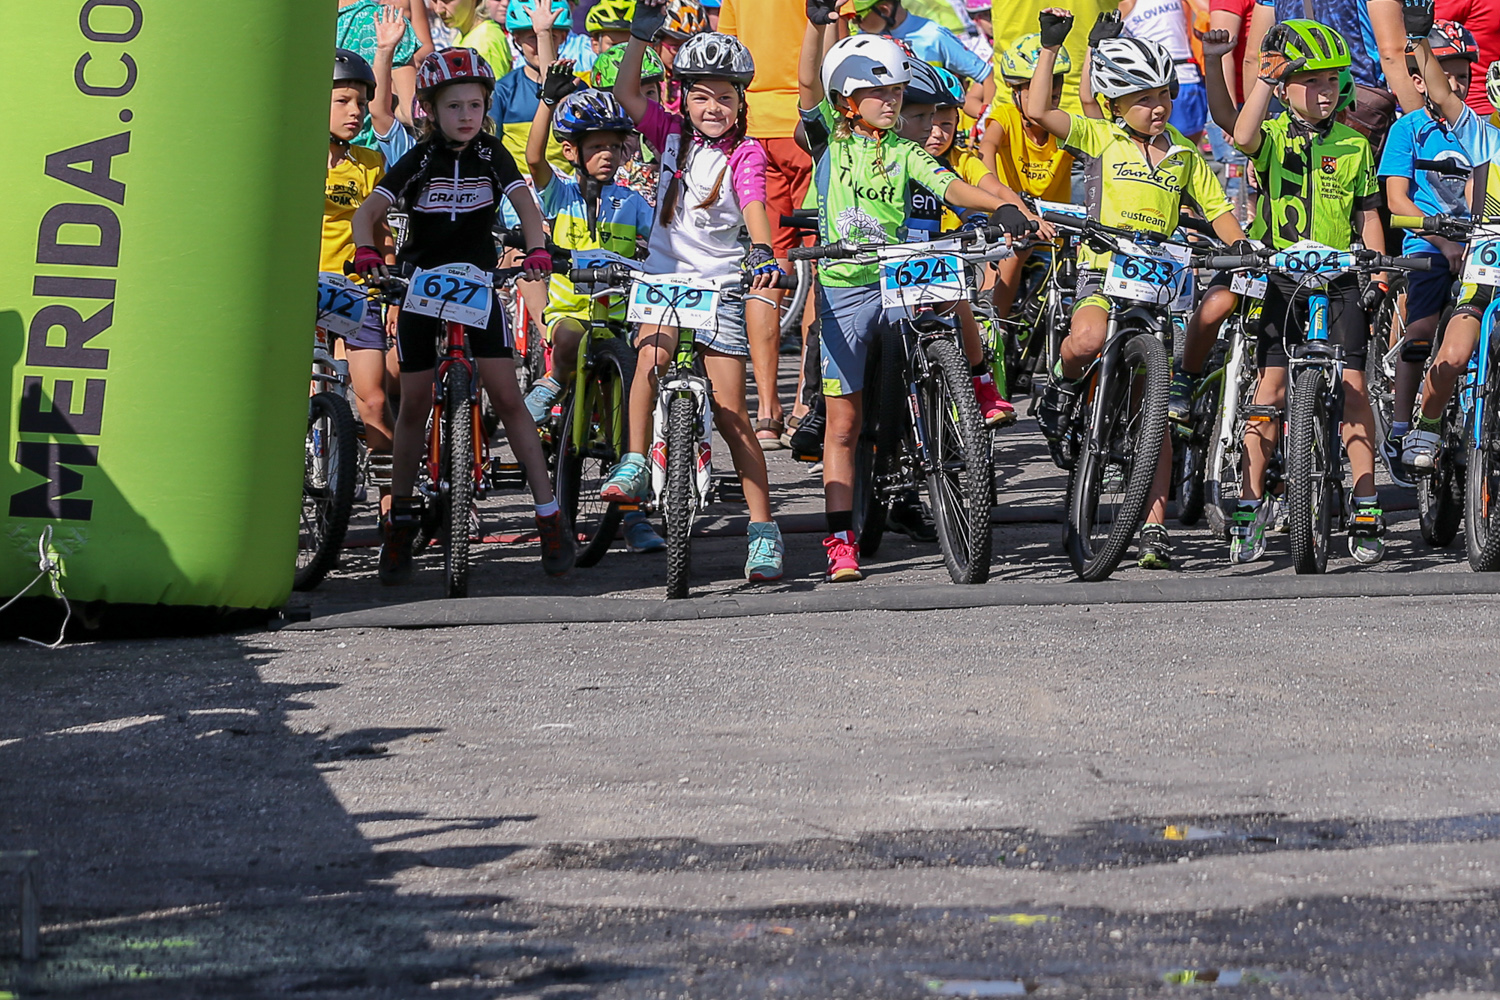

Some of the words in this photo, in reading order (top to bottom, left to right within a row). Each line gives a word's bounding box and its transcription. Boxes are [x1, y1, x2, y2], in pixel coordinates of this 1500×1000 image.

[1131, 1, 1181, 24] SLOVAKIA
[1164, 175, 1183, 194] Ga
[429, 192, 472, 204] CRAFT
[1120, 209, 1167, 229] eustream
[895, 258, 949, 287] 624
[1122, 254, 1175, 286] 623
[1285, 250, 1341, 273] 604
[423, 274, 486, 304] 627
[646, 284, 703, 309] 619
